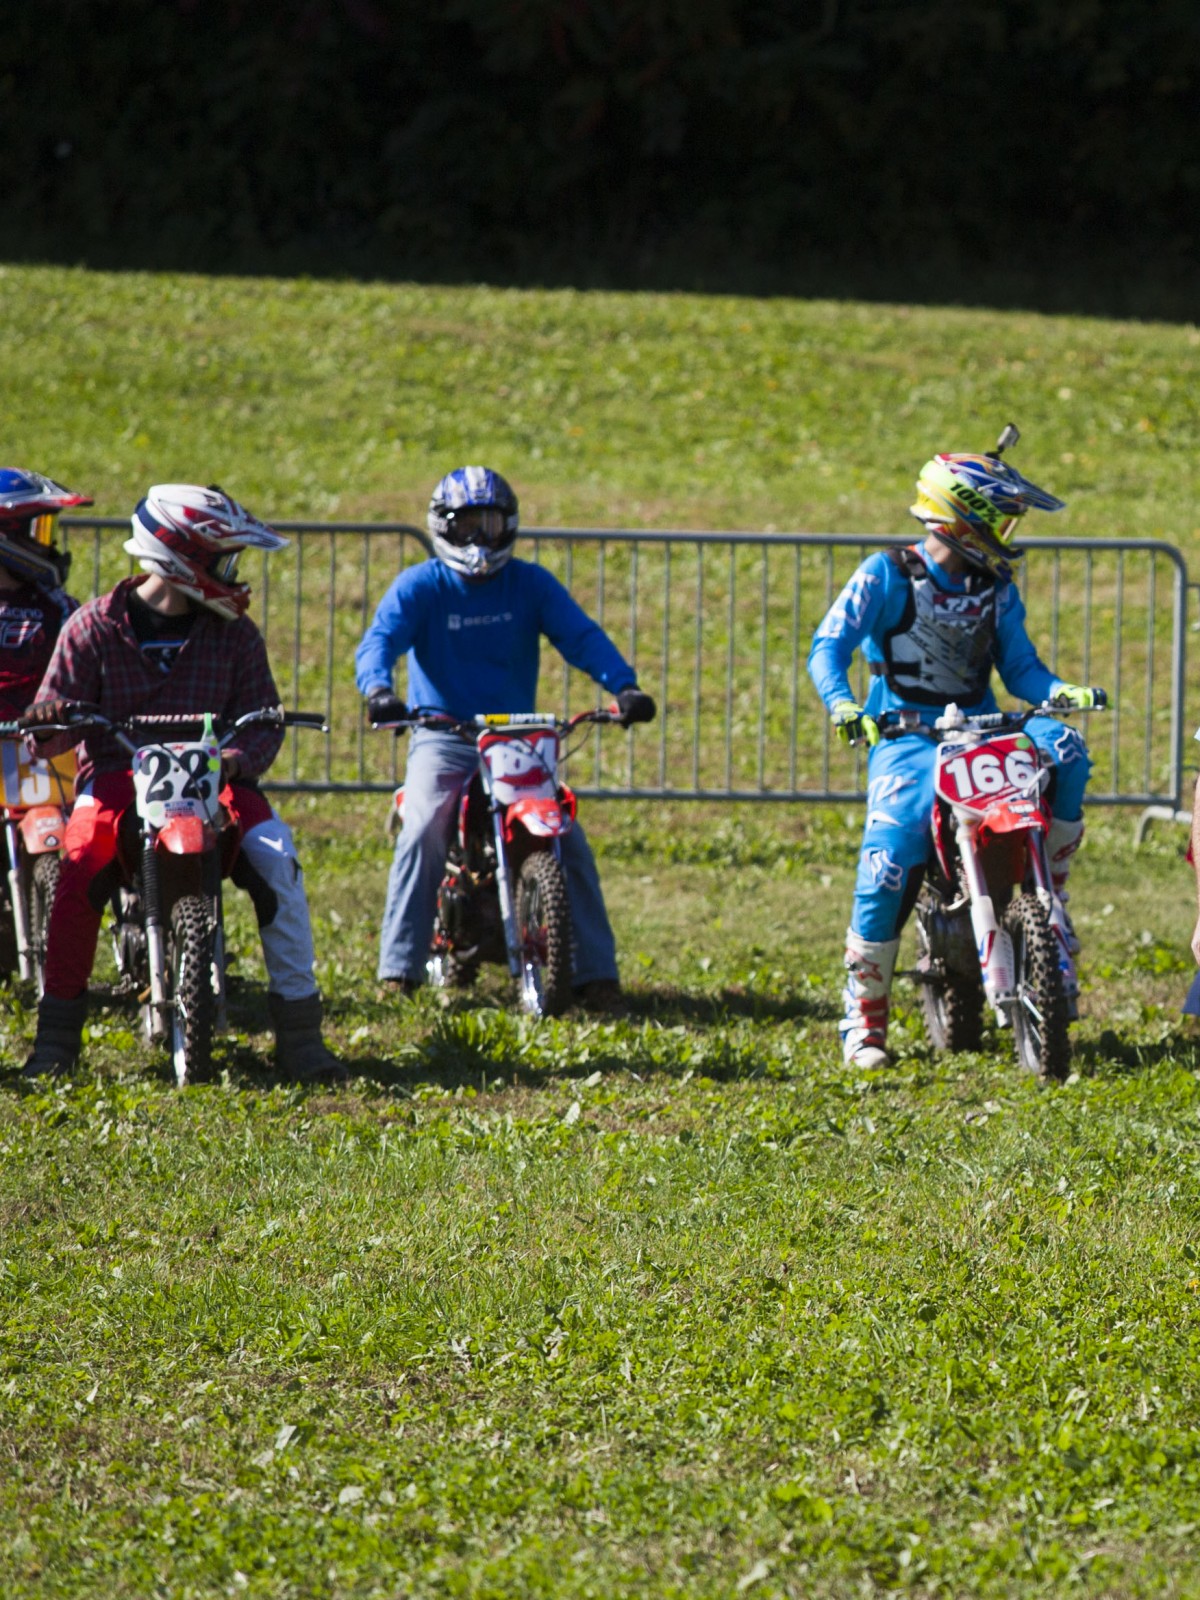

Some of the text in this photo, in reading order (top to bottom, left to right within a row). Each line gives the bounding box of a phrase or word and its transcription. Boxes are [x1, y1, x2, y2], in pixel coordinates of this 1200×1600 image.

[950, 482, 1001, 523] 100%
[140, 751, 212, 804] 22
[945, 750, 1036, 799] 166
